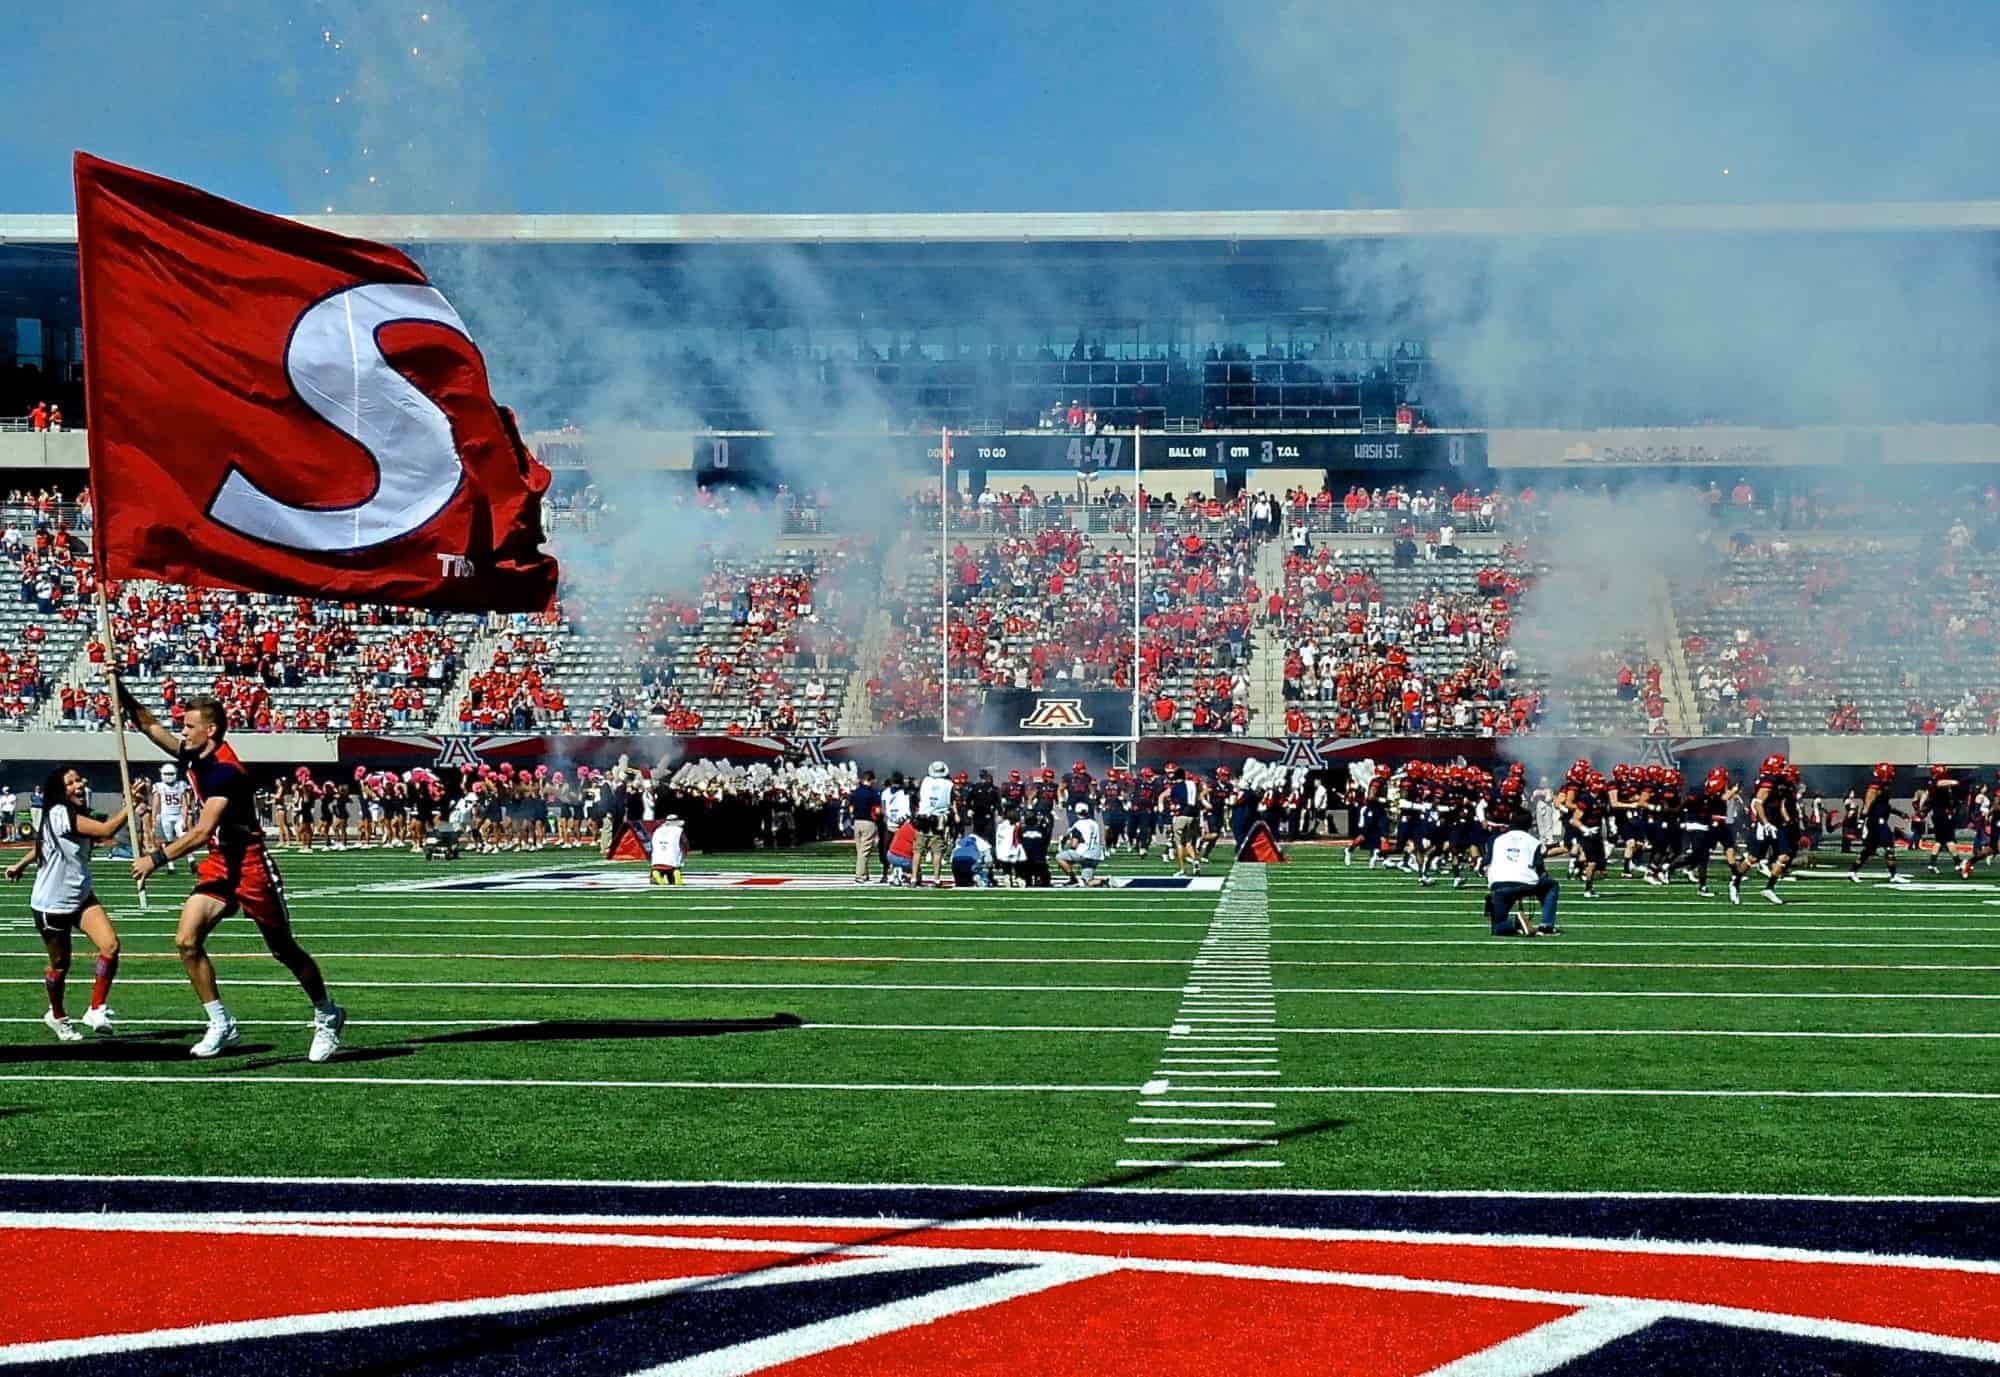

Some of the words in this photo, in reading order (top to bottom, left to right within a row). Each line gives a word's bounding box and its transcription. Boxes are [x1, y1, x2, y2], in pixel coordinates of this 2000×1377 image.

[206, 282, 475, 552] S
[978, 447, 991, 459] TO
[992, 447, 1007, 459] GO
[1066, 438, 1122, 468] 4:47
[1168, 447, 1191, 457] BALL
[1192, 447, 1206, 457] ON
[1261, 441, 1273, 463] 3
[1385, 443, 1403, 459] ST.
[436, 553, 475, 578] TM
[1020, 698, 1094, 729] A
